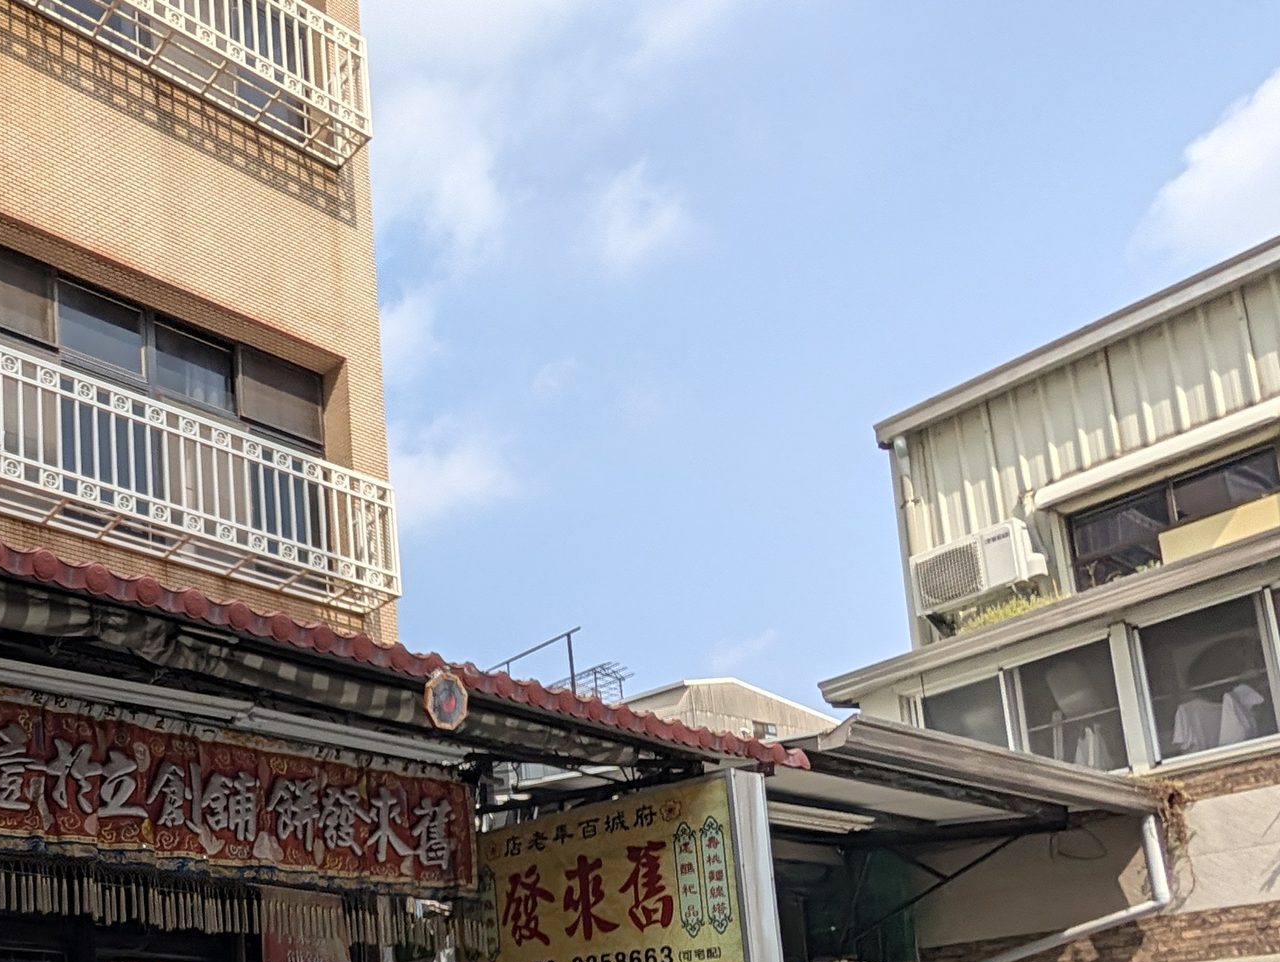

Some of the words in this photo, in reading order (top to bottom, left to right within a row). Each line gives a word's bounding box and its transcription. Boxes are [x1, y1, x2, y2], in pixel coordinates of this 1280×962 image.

[504, 805, 657, 857] 府城百年老店
[502, 840, 675, 946] 舊來發
